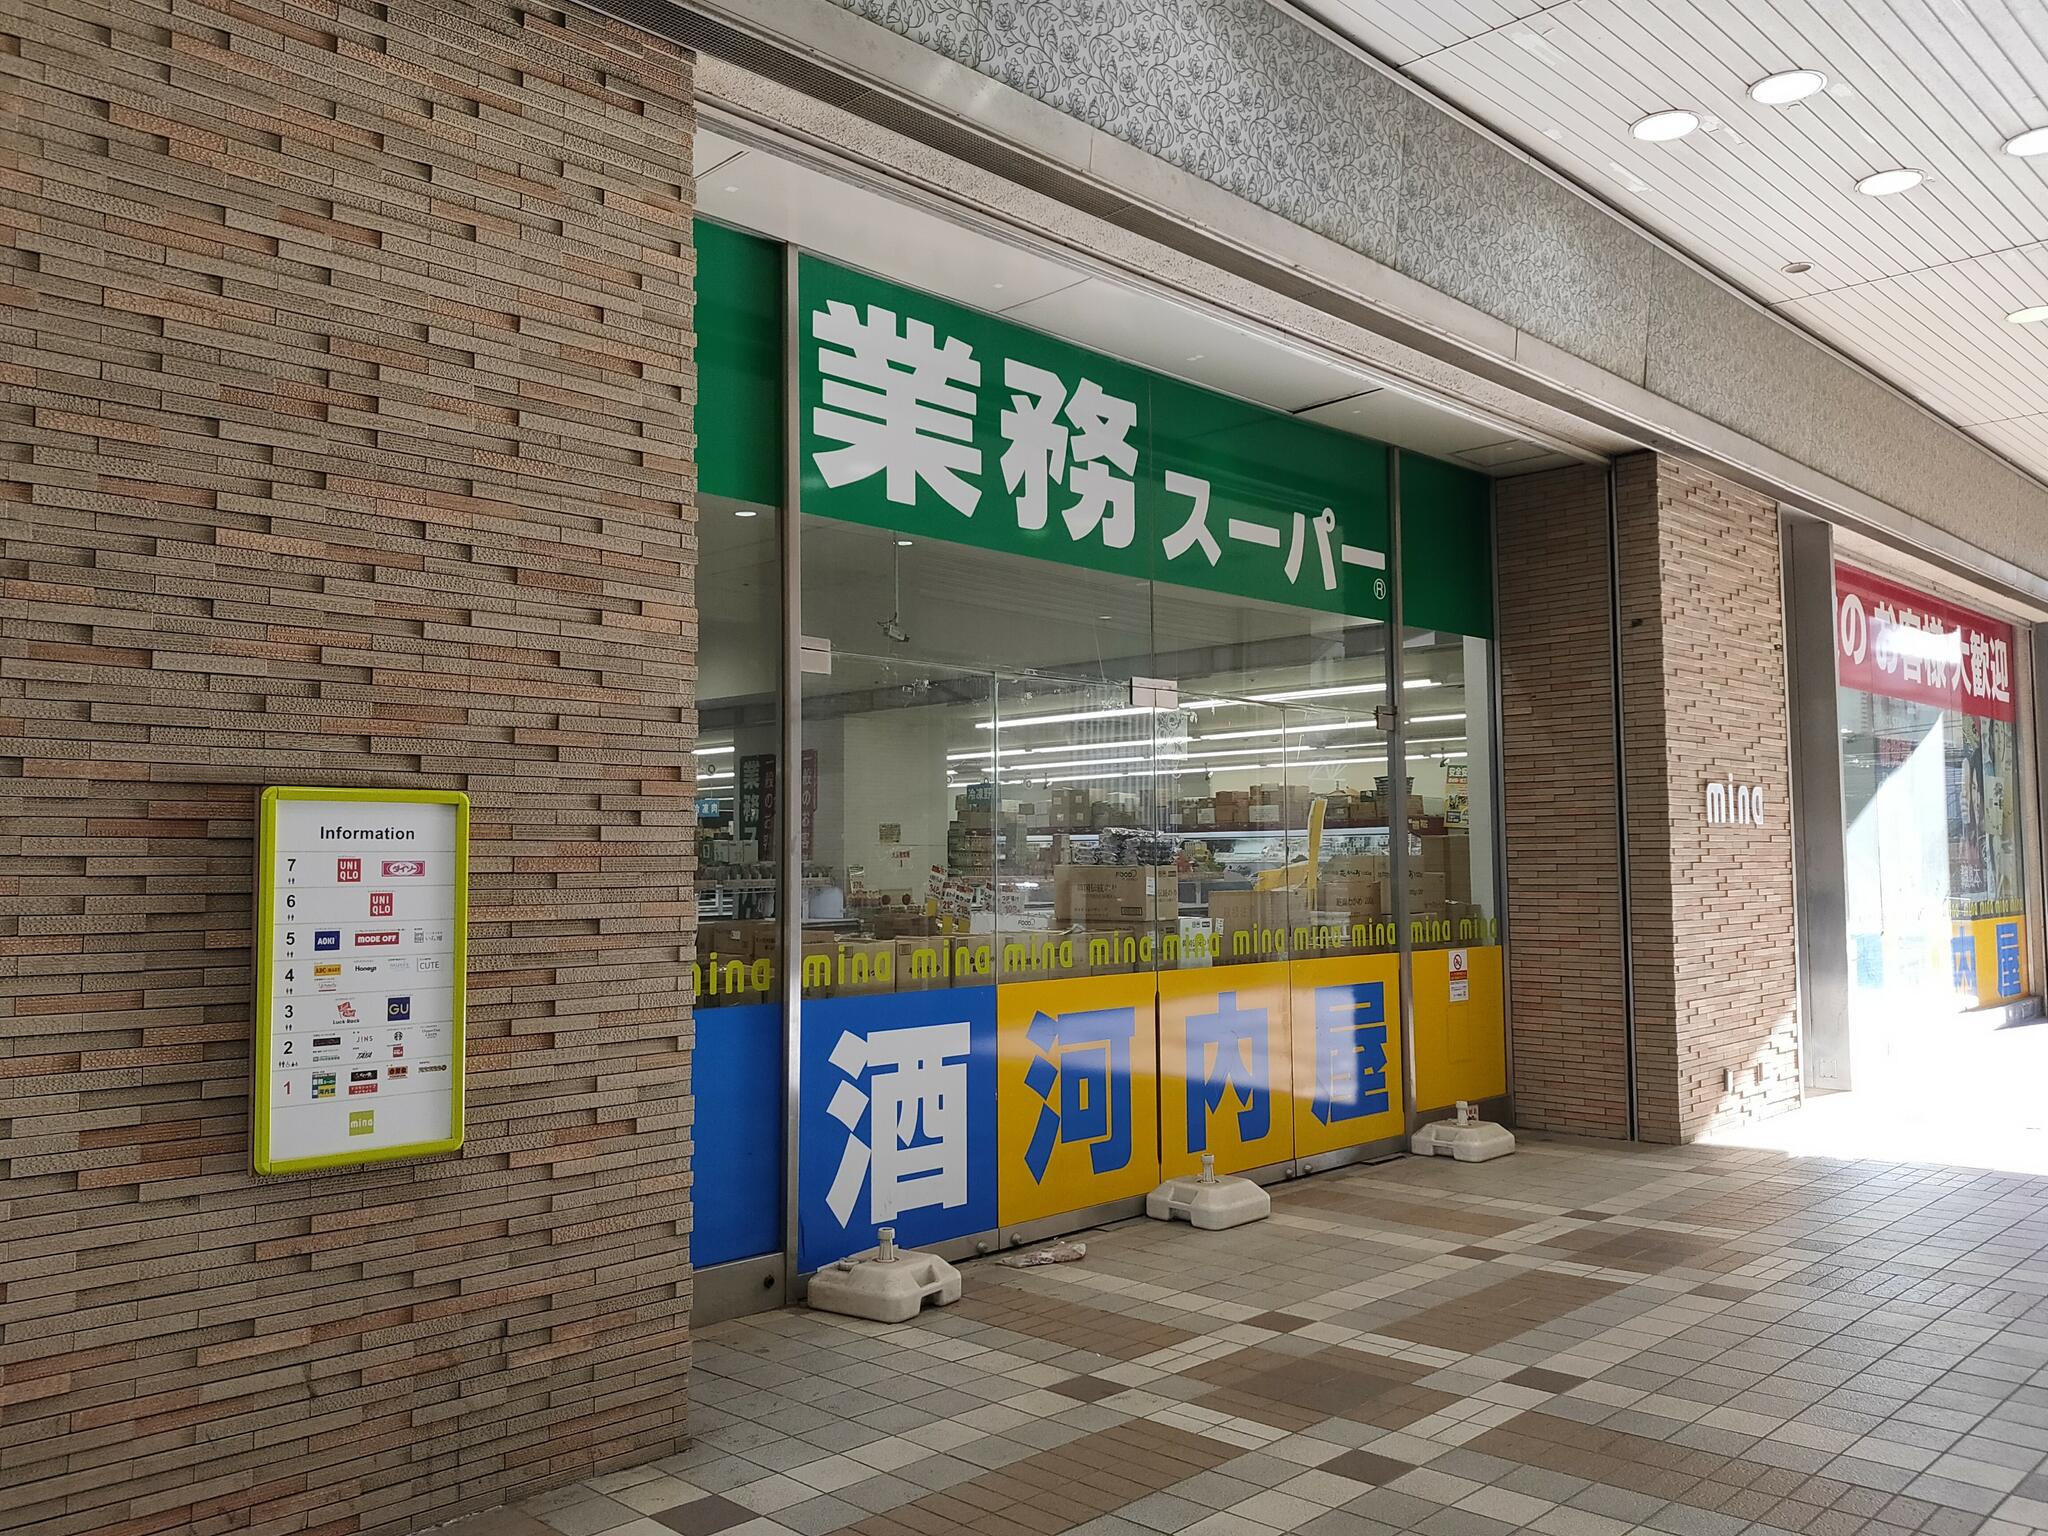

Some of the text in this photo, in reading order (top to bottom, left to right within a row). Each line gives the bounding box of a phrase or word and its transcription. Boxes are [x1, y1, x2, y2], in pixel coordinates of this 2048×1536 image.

[812, 299, 1386, 590] 業務スーパー
[1835, 594, 2010, 703] のお客様大歓迎
[1706, 773, 1764, 825] mina
[320, 826, 415, 841] Information
[287, 858, 297, 872] 7
[340, 861, 358, 870] UNI
[340, 871, 359, 881] QLO
[286, 894, 296, 908] 6
[372, 895, 390, 905] UNI
[372, 905, 391, 915] QLO
[286, 932, 296, 946] 5
[317, 937, 336, 945] AOKI
[802, 944, 892, 988] mina
[911, 939, 990, 979] mina
[1003, 934, 1073, 973] mina
[1089, 930, 1152, 967] mina
[1162, 927, 1220, 961] mina
[1232, 923, 1285, 957] mina
[1351, 917, 1396, 948] mina
[1410, 914, 1451, 943] mina
[1459, 912, 1497, 941] mina
[419, 961, 440, 970] CUTE
[285, 968, 295, 982] 4
[284, 1004, 294, 1019] 3
[388, 1003, 409, 1015] GU
[356, 1035, 374, 1043] JINS
[283, 1041, 293, 1055] 2
[283, 1081, 291, 1095] 1
[825, 981, 1391, 1229] 酒 河内屋
[350, 1118, 373, 1129] mina
